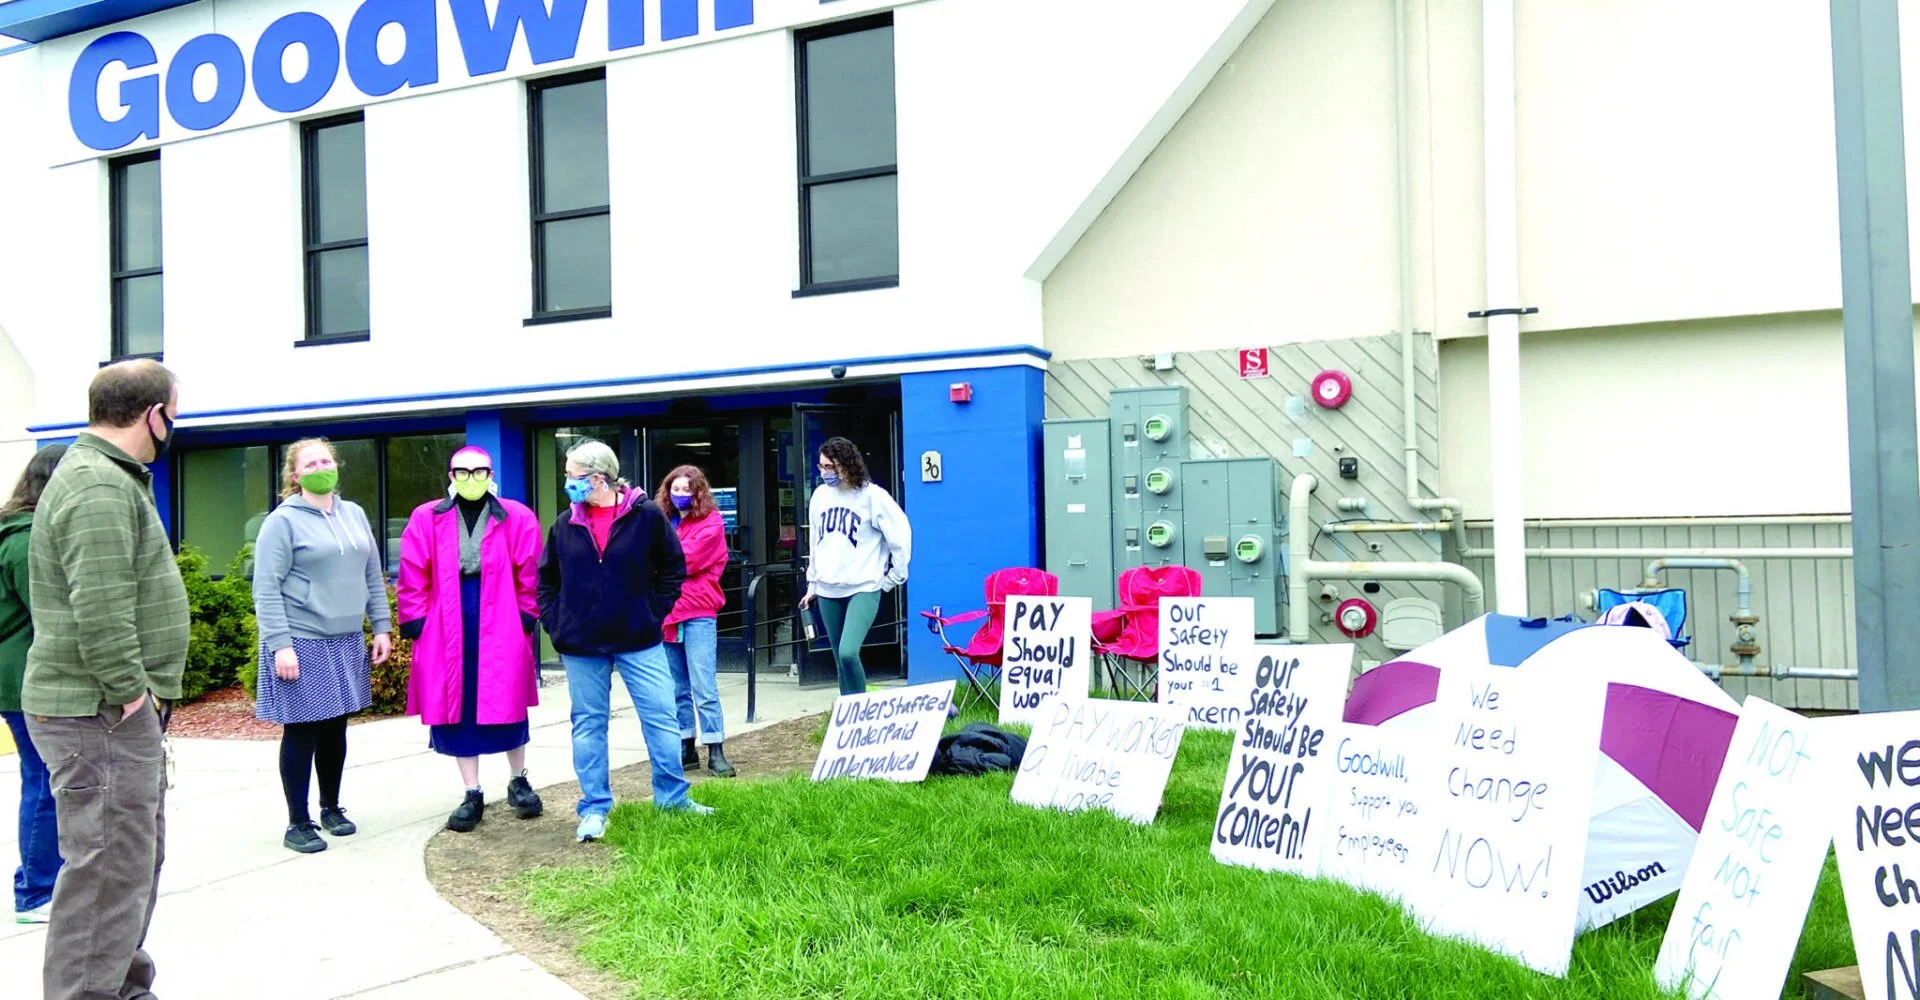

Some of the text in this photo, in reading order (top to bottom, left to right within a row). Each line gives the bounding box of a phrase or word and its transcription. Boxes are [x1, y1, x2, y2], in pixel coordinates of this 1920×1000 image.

[68, 0, 754, 150] Goodw
[925, 456, 940, 479] 30
[817, 506, 862, 549] DUKE
[1008, 666, 1062, 689] equal
[1219, 655, 1239, 675] be
[1013, 690, 1059, 709] wor
[1167, 680, 1193, 694] your
[1471, 682, 1499, 710] We
[1298, 725, 1324, 758] Be
[1455, 722, 1517, 755] Need
[1060, 748, 1121, 787] livable
[1448, 766, 1548, 823] Change
[1856, 801, 1920, 851] Nee
[1337, 825, 1408, 864] Employees
[1584, 861, 1667, 904] Wilson
